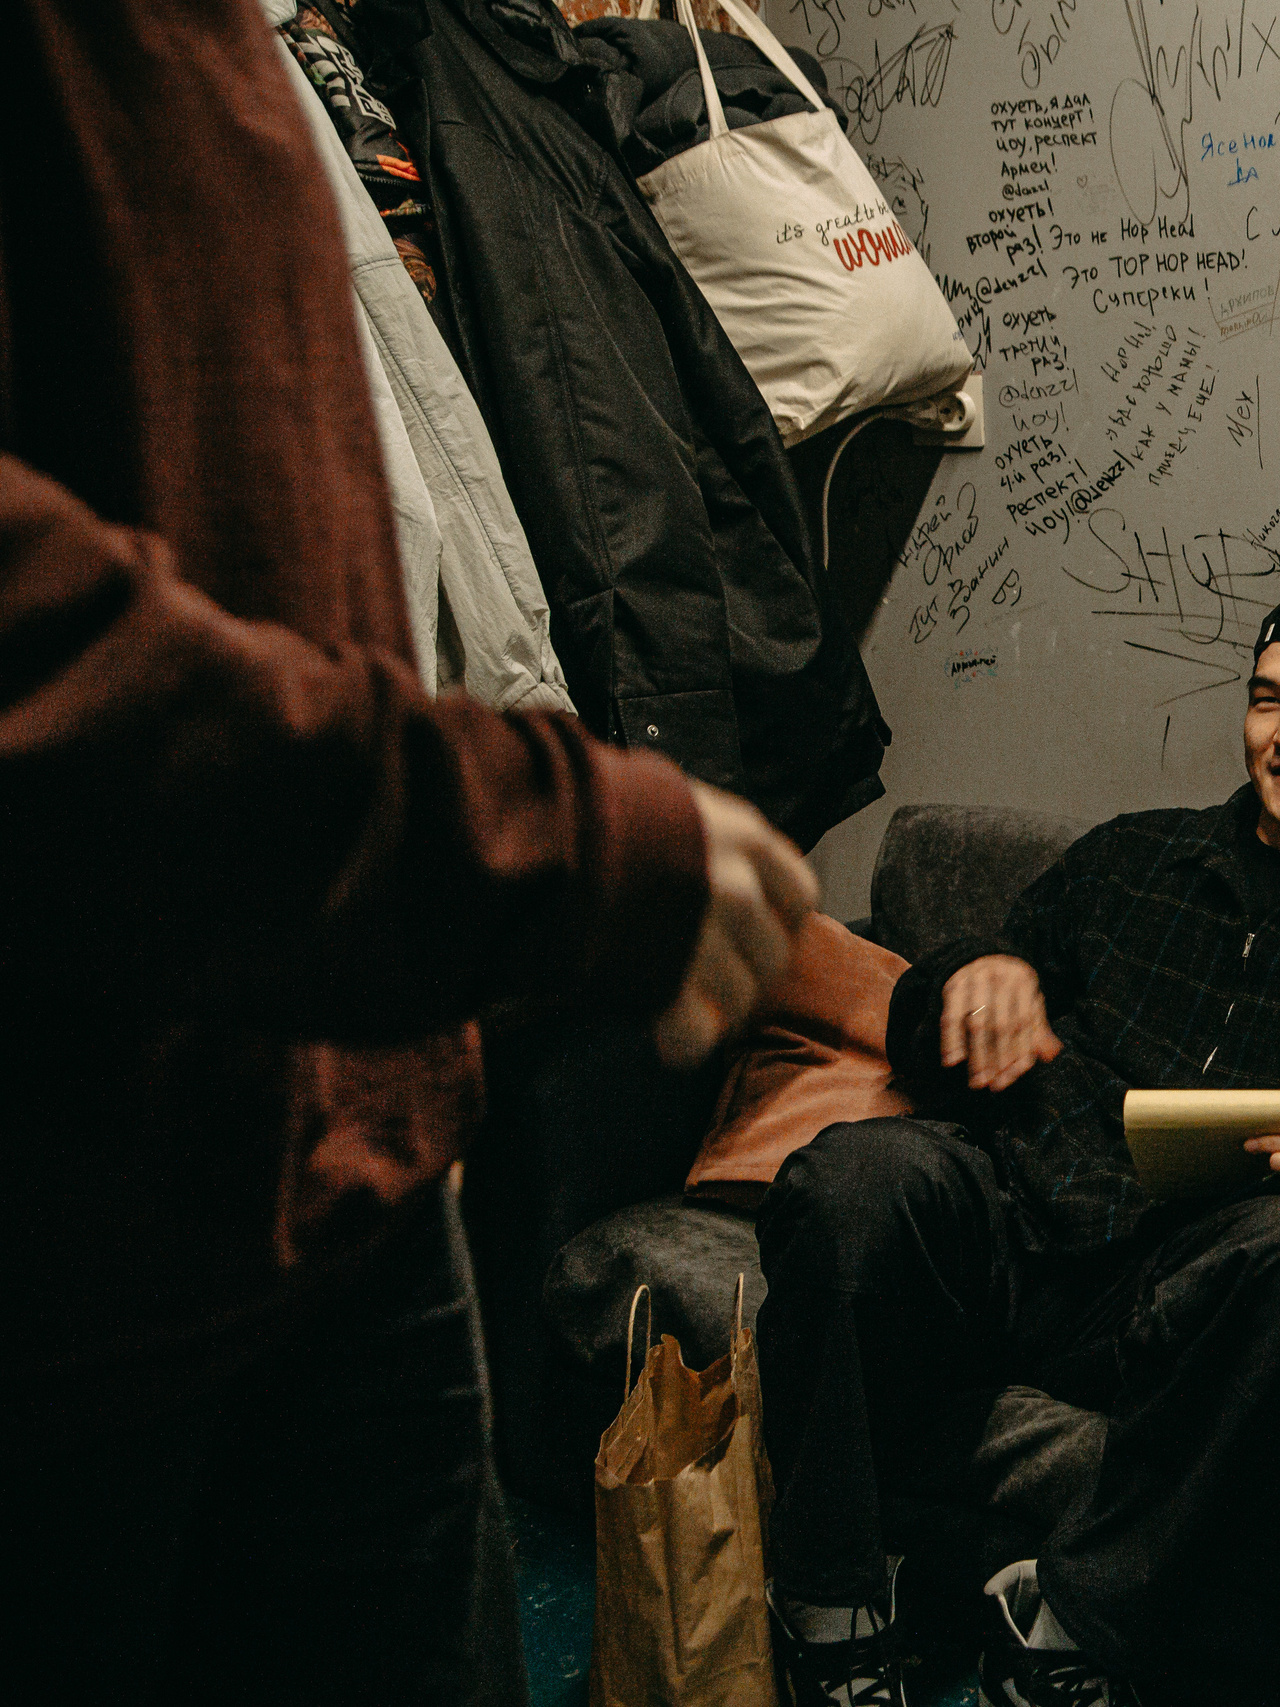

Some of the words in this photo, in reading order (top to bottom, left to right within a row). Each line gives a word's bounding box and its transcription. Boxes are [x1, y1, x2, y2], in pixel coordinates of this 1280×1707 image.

[777, 223, 804, 244] it's
[816, 204, 863, 247] great
[988, 197, 1054, 223] охуеть!
[966, 224, 1017, 255] второй
[1006, 224, 1044, 266] раз!
[1050, 224, 1081, 250] Это
[1158, 213, 1195, 238] Head
[1063, 266, 1098, 290] Это
[1197, 248, 1248, 273] HEAD!
[1003, 305, 1057, 335] охуеть
[995, 435, 1053, 469] охуеть
